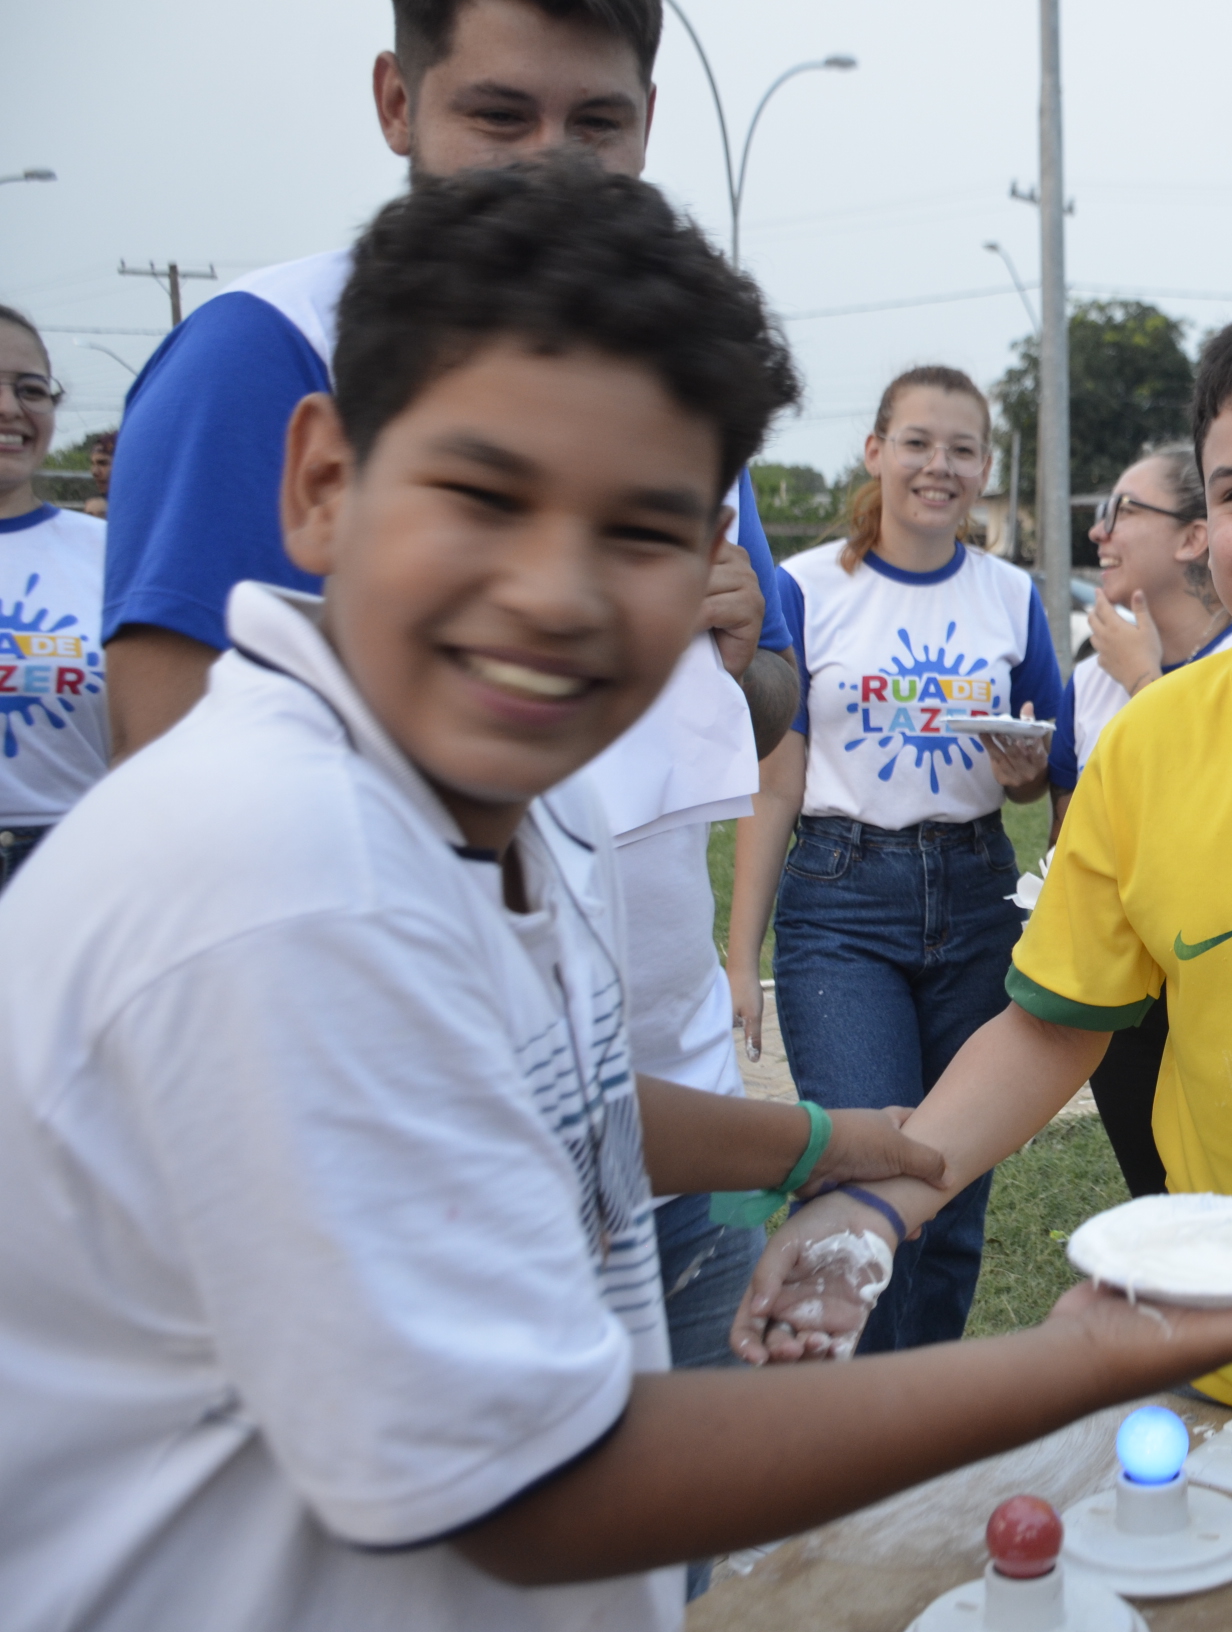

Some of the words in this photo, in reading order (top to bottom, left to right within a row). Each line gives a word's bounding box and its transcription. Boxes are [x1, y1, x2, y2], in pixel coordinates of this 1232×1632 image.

[31, 636, 77, 656] DE
[0, 665, 85, 696] ZER
[861, 675, 948, 703] RUA
[952, 681, 988, 700] DE
[862, 707, 989, 733] LAZ
